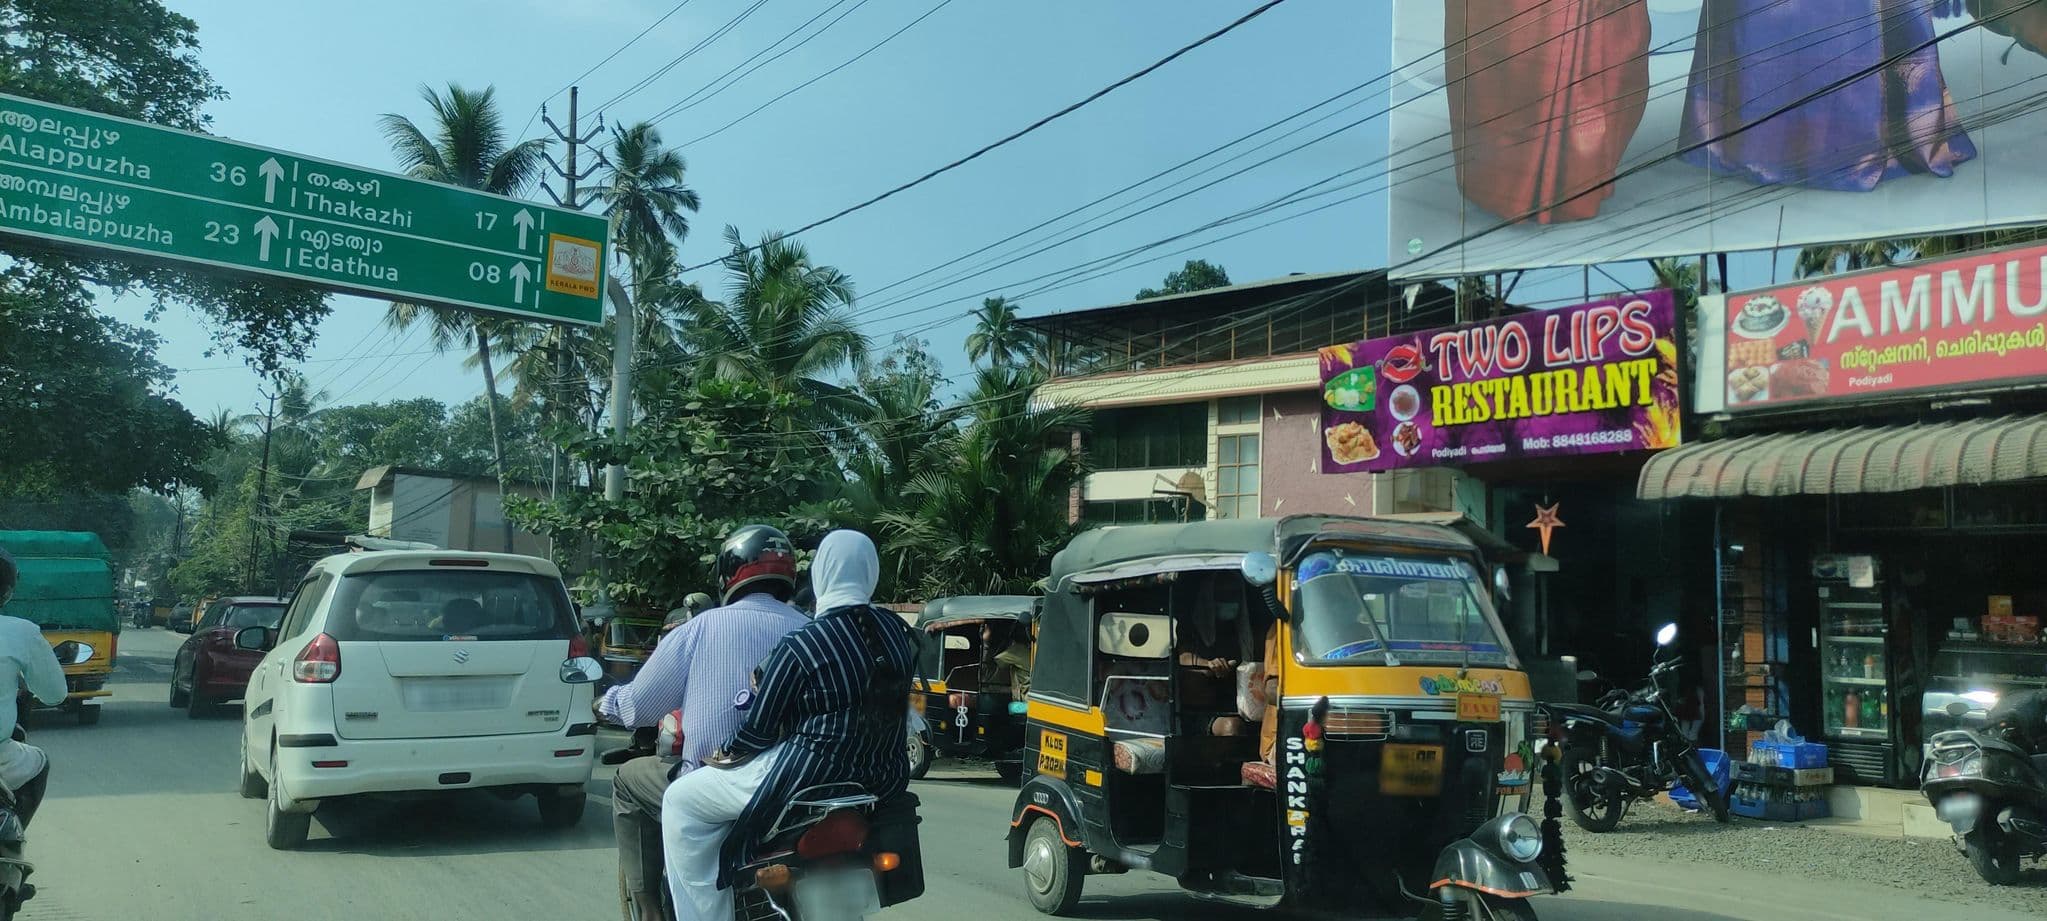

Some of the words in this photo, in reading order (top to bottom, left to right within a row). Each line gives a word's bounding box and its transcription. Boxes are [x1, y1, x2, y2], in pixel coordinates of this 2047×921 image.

[0, 110, 120, 150] ആലപ്പുഴ
[0, 135, 151, 180] Alappuzha
[210, 162, 247, 187] 36
[307, 172, 381, 198] തകഴി
[304, 192, 413, 229] Thakazhi
[476, 212, 498, 231] 17
[204, 221, 240, 245] 23
[299, 250, 398, 282] Edathua
[469, 262, 500, 284] 08
[1431, 321, 1531, 381] TWO
[1544, 300, 1656, 369] LIPS
[1431, 358, 1658, 428] RESTAURANT
[1849, 373, 1893, 387] Podiyadi
[1523, 438, 1550, 450] Mob:
